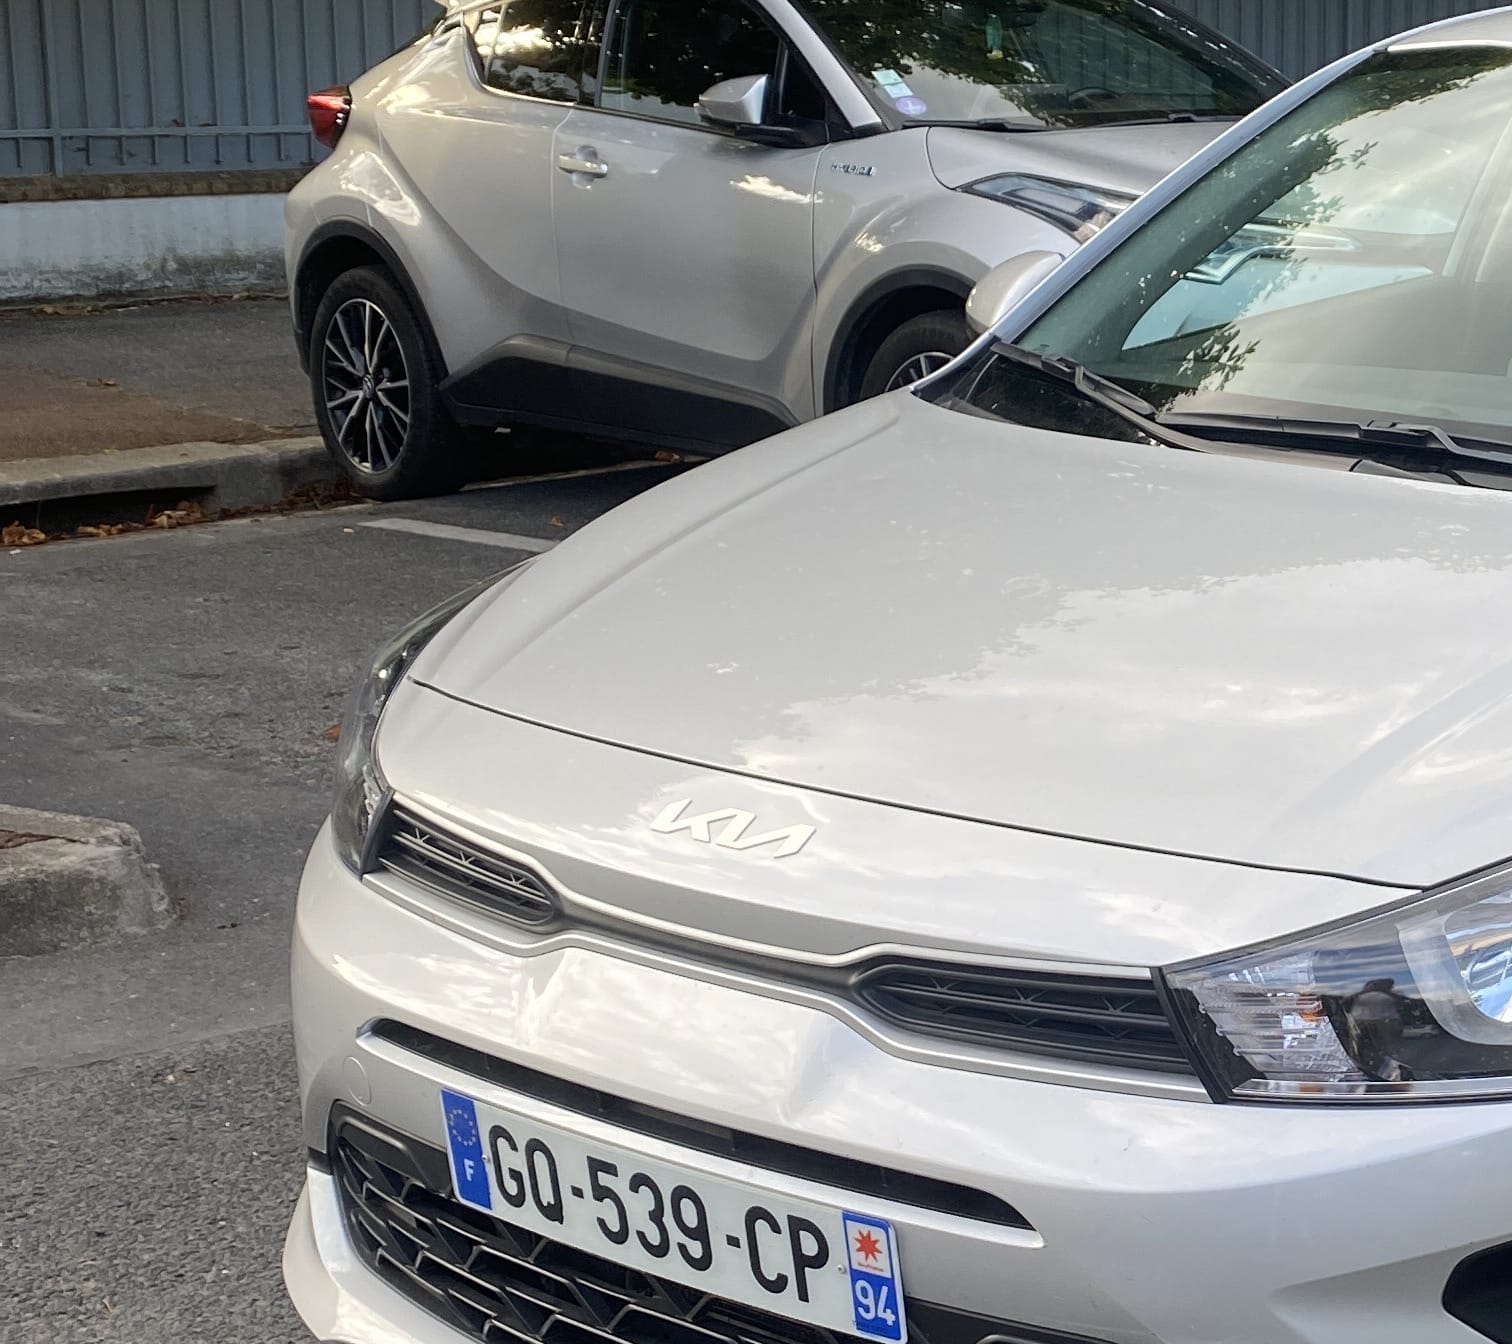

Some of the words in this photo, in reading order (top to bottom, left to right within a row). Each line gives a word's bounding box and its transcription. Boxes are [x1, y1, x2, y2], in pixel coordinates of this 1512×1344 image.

[650, 798, 816, 859] KIA
[463, 1158, 475, 1182] F
[488, 1124, 830, 1303] GQ-539-CP
[855, 1279, 896, 1327] 94
